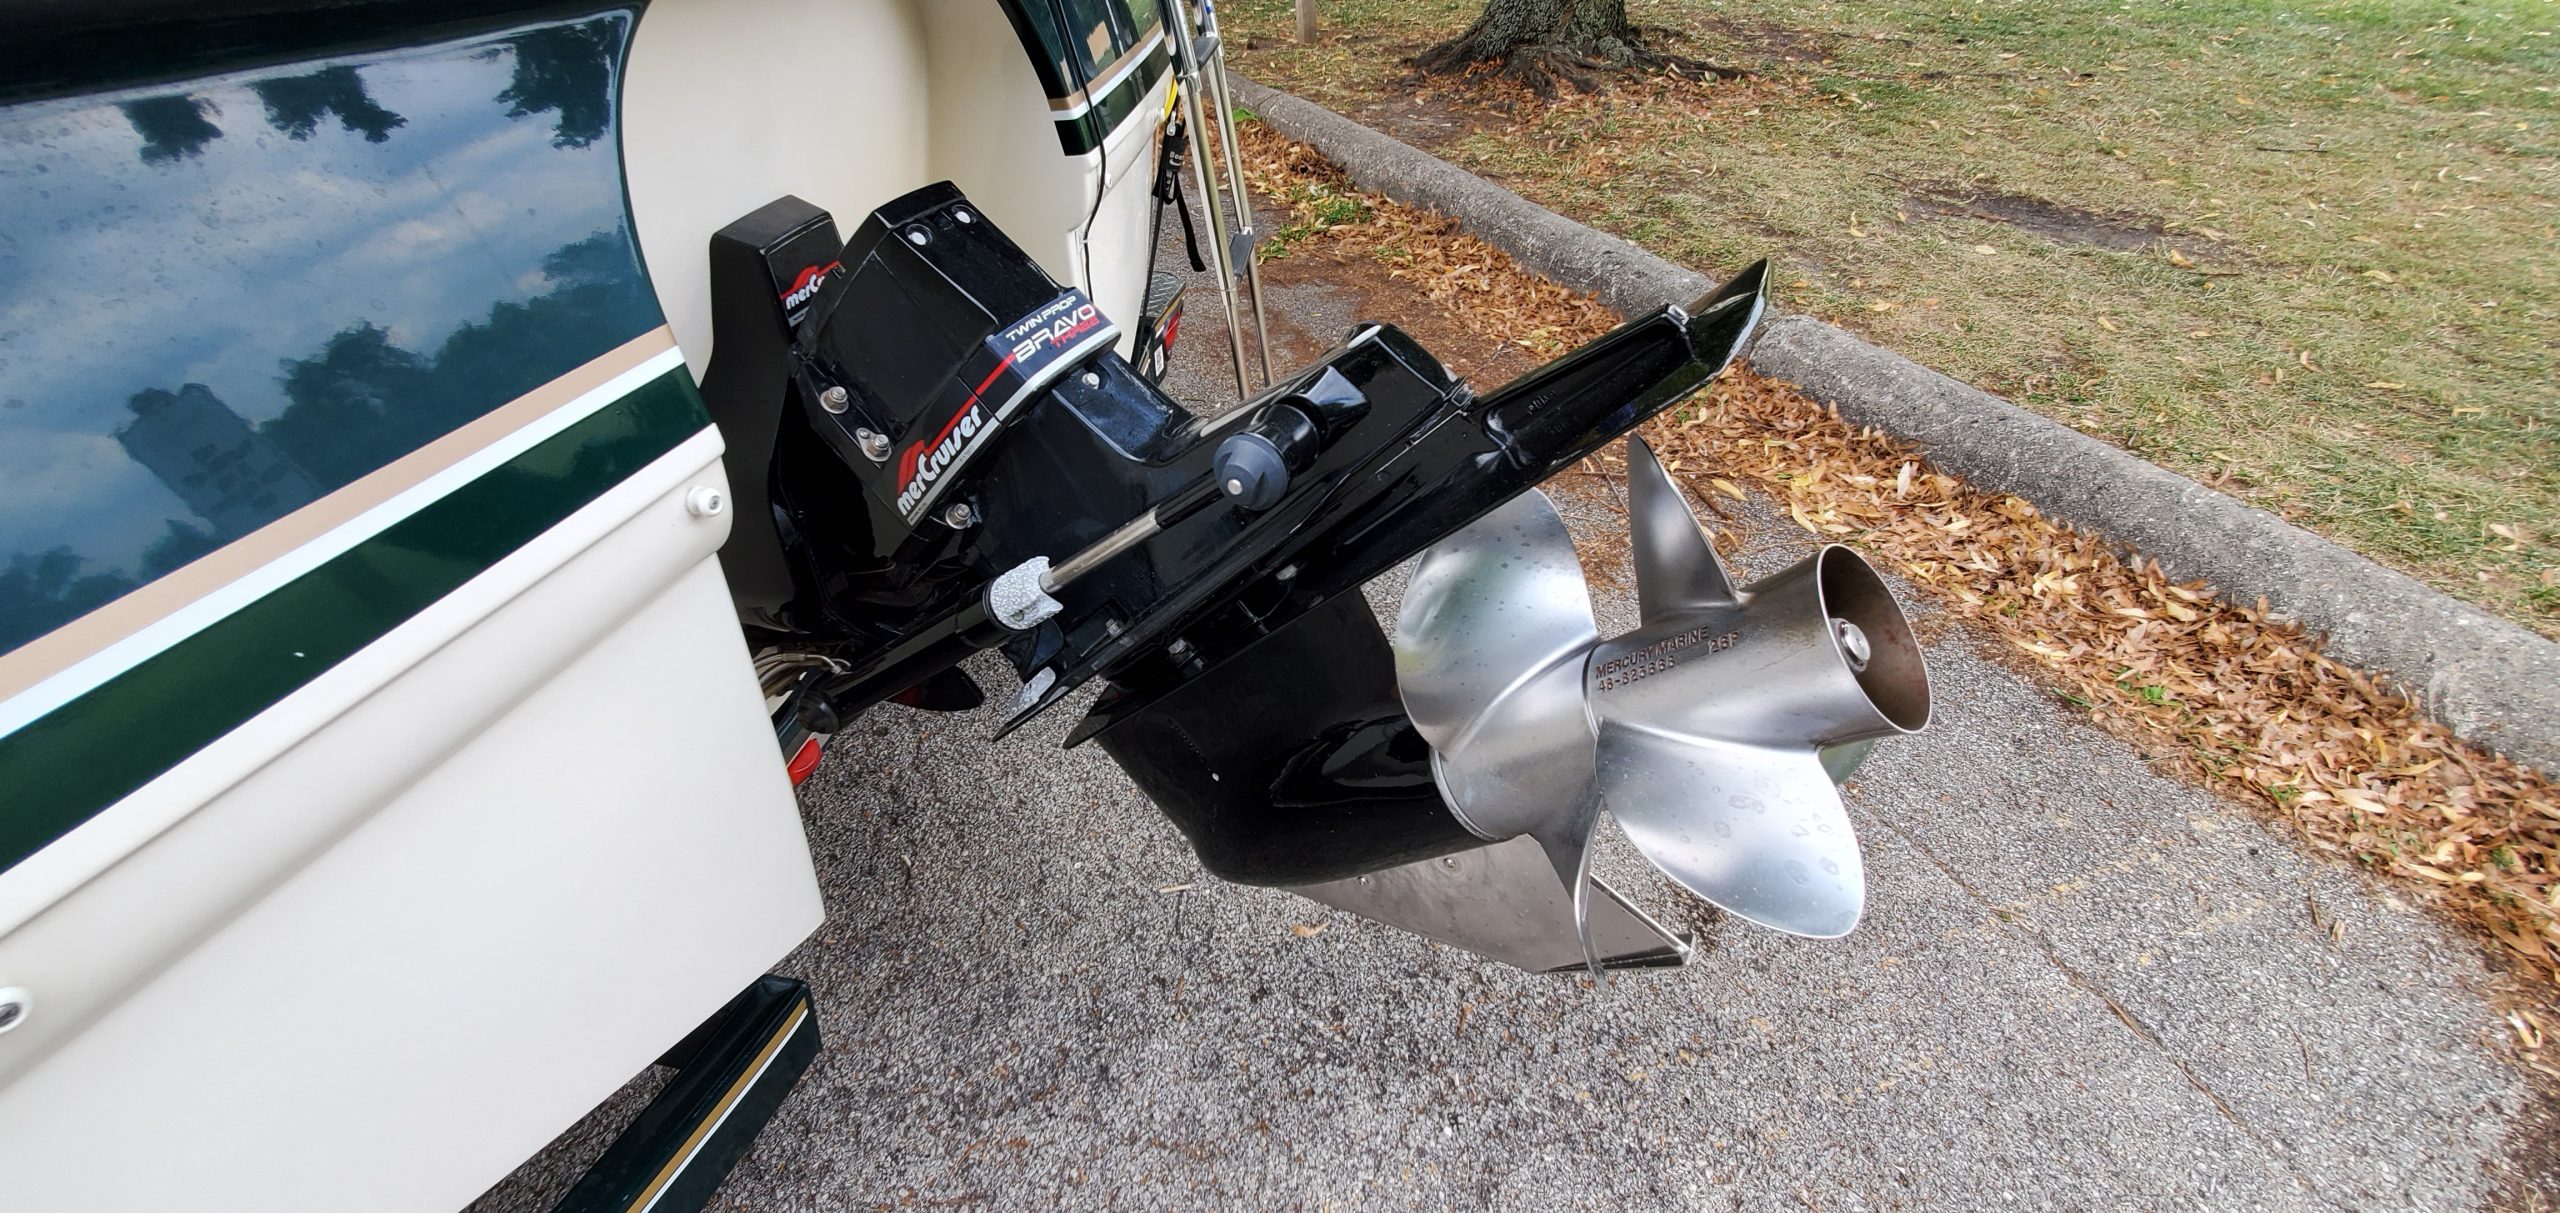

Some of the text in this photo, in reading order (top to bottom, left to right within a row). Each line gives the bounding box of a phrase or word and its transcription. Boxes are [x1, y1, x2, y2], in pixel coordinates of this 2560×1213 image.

[1005, 295, 1077, 341] TWIN PROP
[1012, 303, 1096, 364] BRAVO
[1050, 315, 1100, 348] THREE
[1595, 625, 1709, 679] MERCURY MARINE
